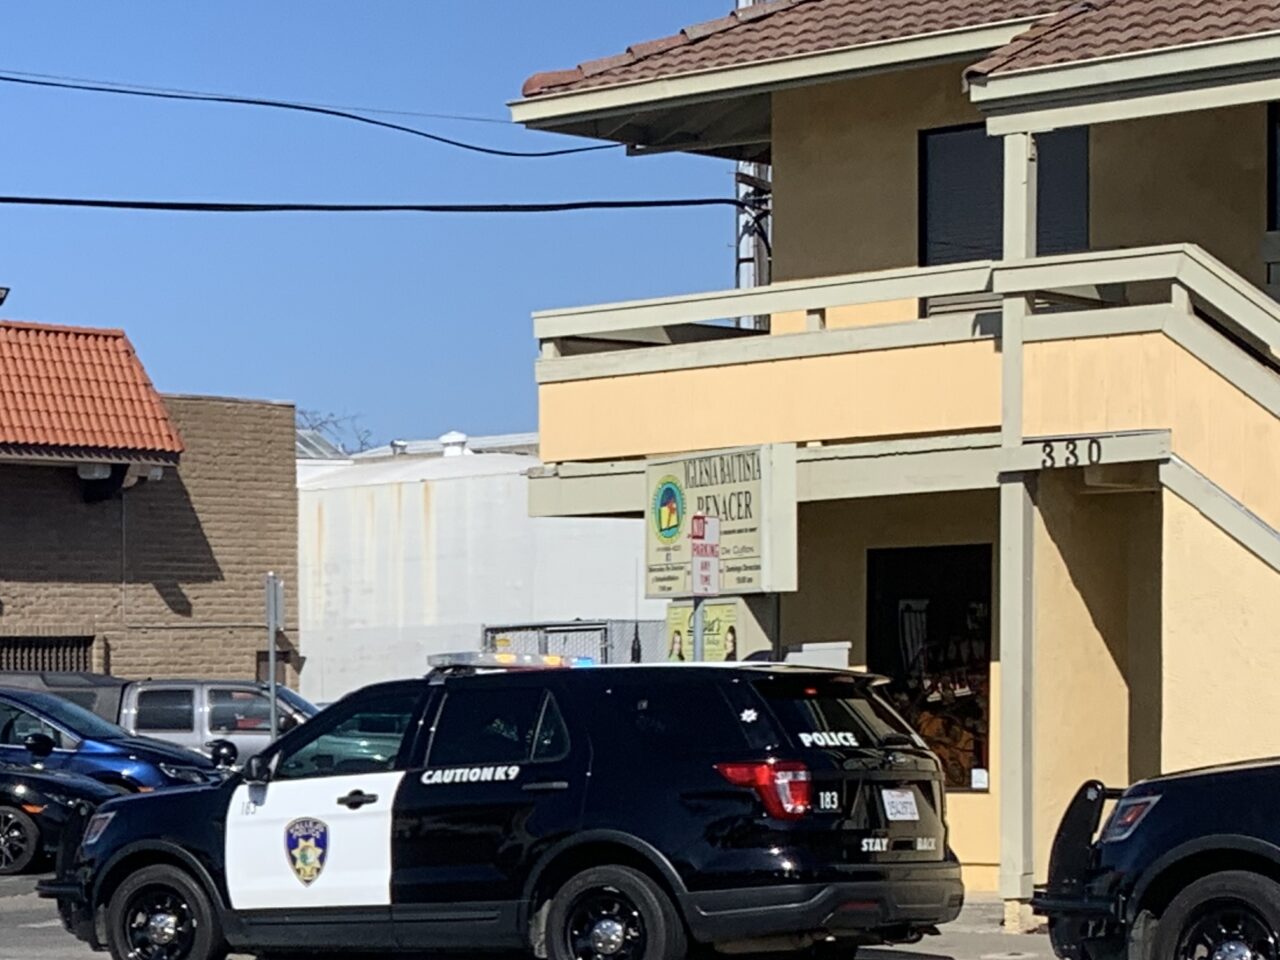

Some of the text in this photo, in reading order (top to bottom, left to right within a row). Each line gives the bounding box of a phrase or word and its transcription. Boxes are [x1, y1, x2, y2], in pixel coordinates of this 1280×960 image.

[1041, 439, 1102, 469] 330
[684, 452, 762, 489] IGLESIA BAUTISTA
[799, 732, 859, 748] POLICE
[421, 765, 520, 785] CAUTION K9
[819, 791, 839, 809] 183
[861, 837, 937, 852] STAY BACK
